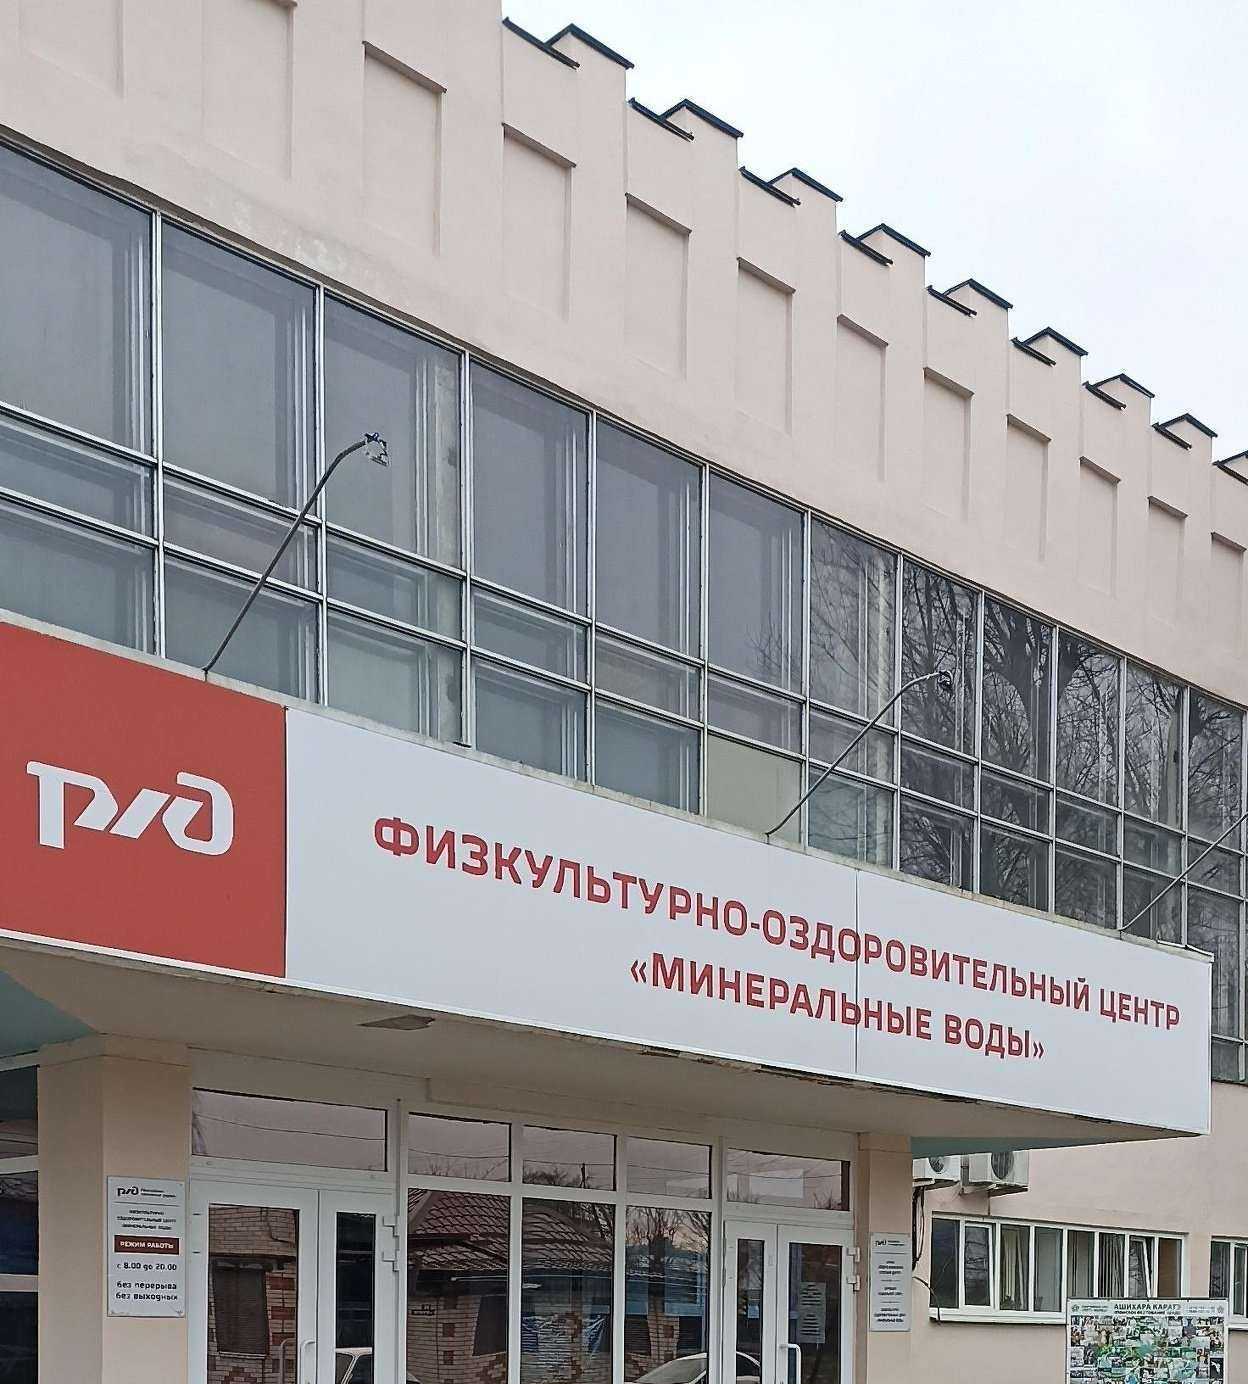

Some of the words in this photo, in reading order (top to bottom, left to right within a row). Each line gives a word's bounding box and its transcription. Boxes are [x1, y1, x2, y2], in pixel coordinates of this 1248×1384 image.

[26, 761, 234, 855] РЖД
[374, 816, 1091, 1013] ФИЗКУЛЬТУРНО-ОЗДОРОВИТЕЛЬНЫЙ
[1099, 988, 1180, 1031] ЦЕНТР
[631, 952, 932, 1041] «МИНЕРАЛЬНЫЕ
[944, 1014, 1045, 1060] ВОДЫ»
[123, 1262, 142, 1270] 8.00
[155, 1263, 177, 1271] 20.00
[116, 1281, 132, 1289] без
[134, 1282, 177, 1290] перерыва
[115, 1292, 131, 1300] без
[133, 1293, 178, 1302] выходных
[1114, 1303, 1151, 1311] АШИХАРА
